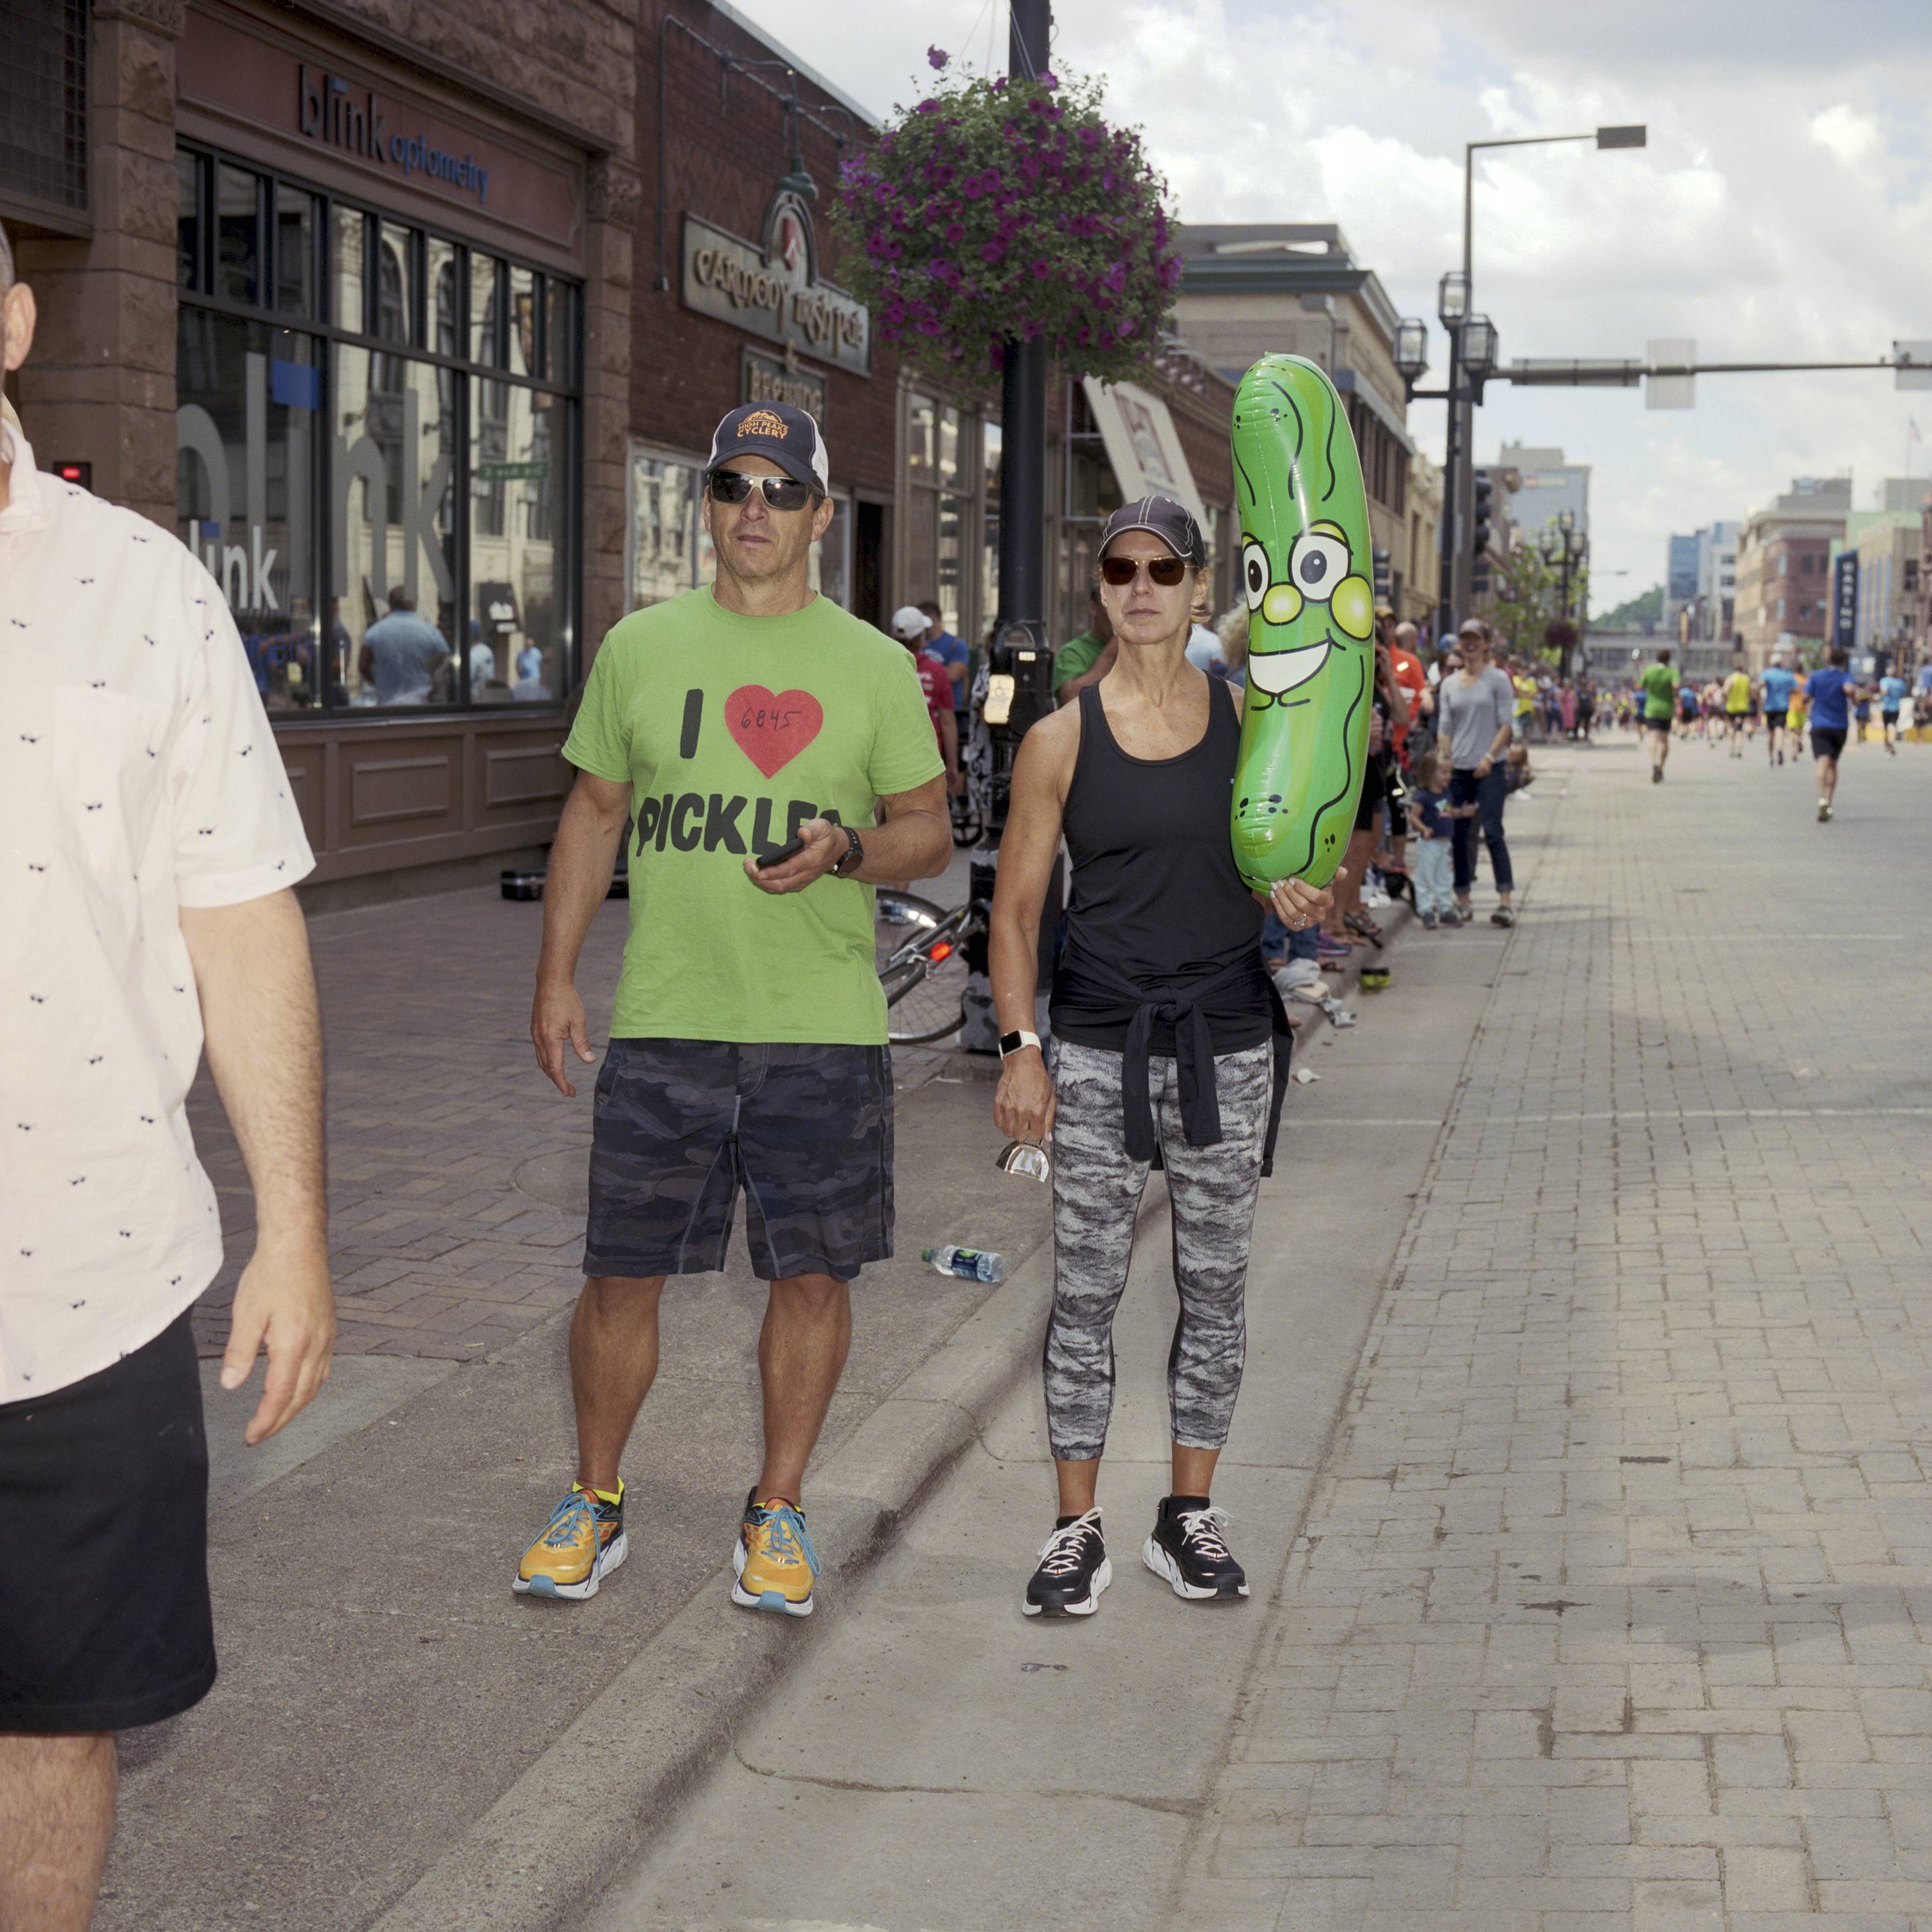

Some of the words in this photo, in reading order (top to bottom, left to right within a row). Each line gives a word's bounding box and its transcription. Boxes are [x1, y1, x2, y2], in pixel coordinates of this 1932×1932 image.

[300, 64, 385, 163] blink
[390, 134, 490, 204] optometry
[737, 426, 788, 439] CYCLERY
[738, 421, 759, 431] HIGH
[761, 421, 788, 433] PEAKS
[680, 688, 704, 759] I
[741, 707, 801, 730] 6845
[636, 793, 842, 857] PICKLE
